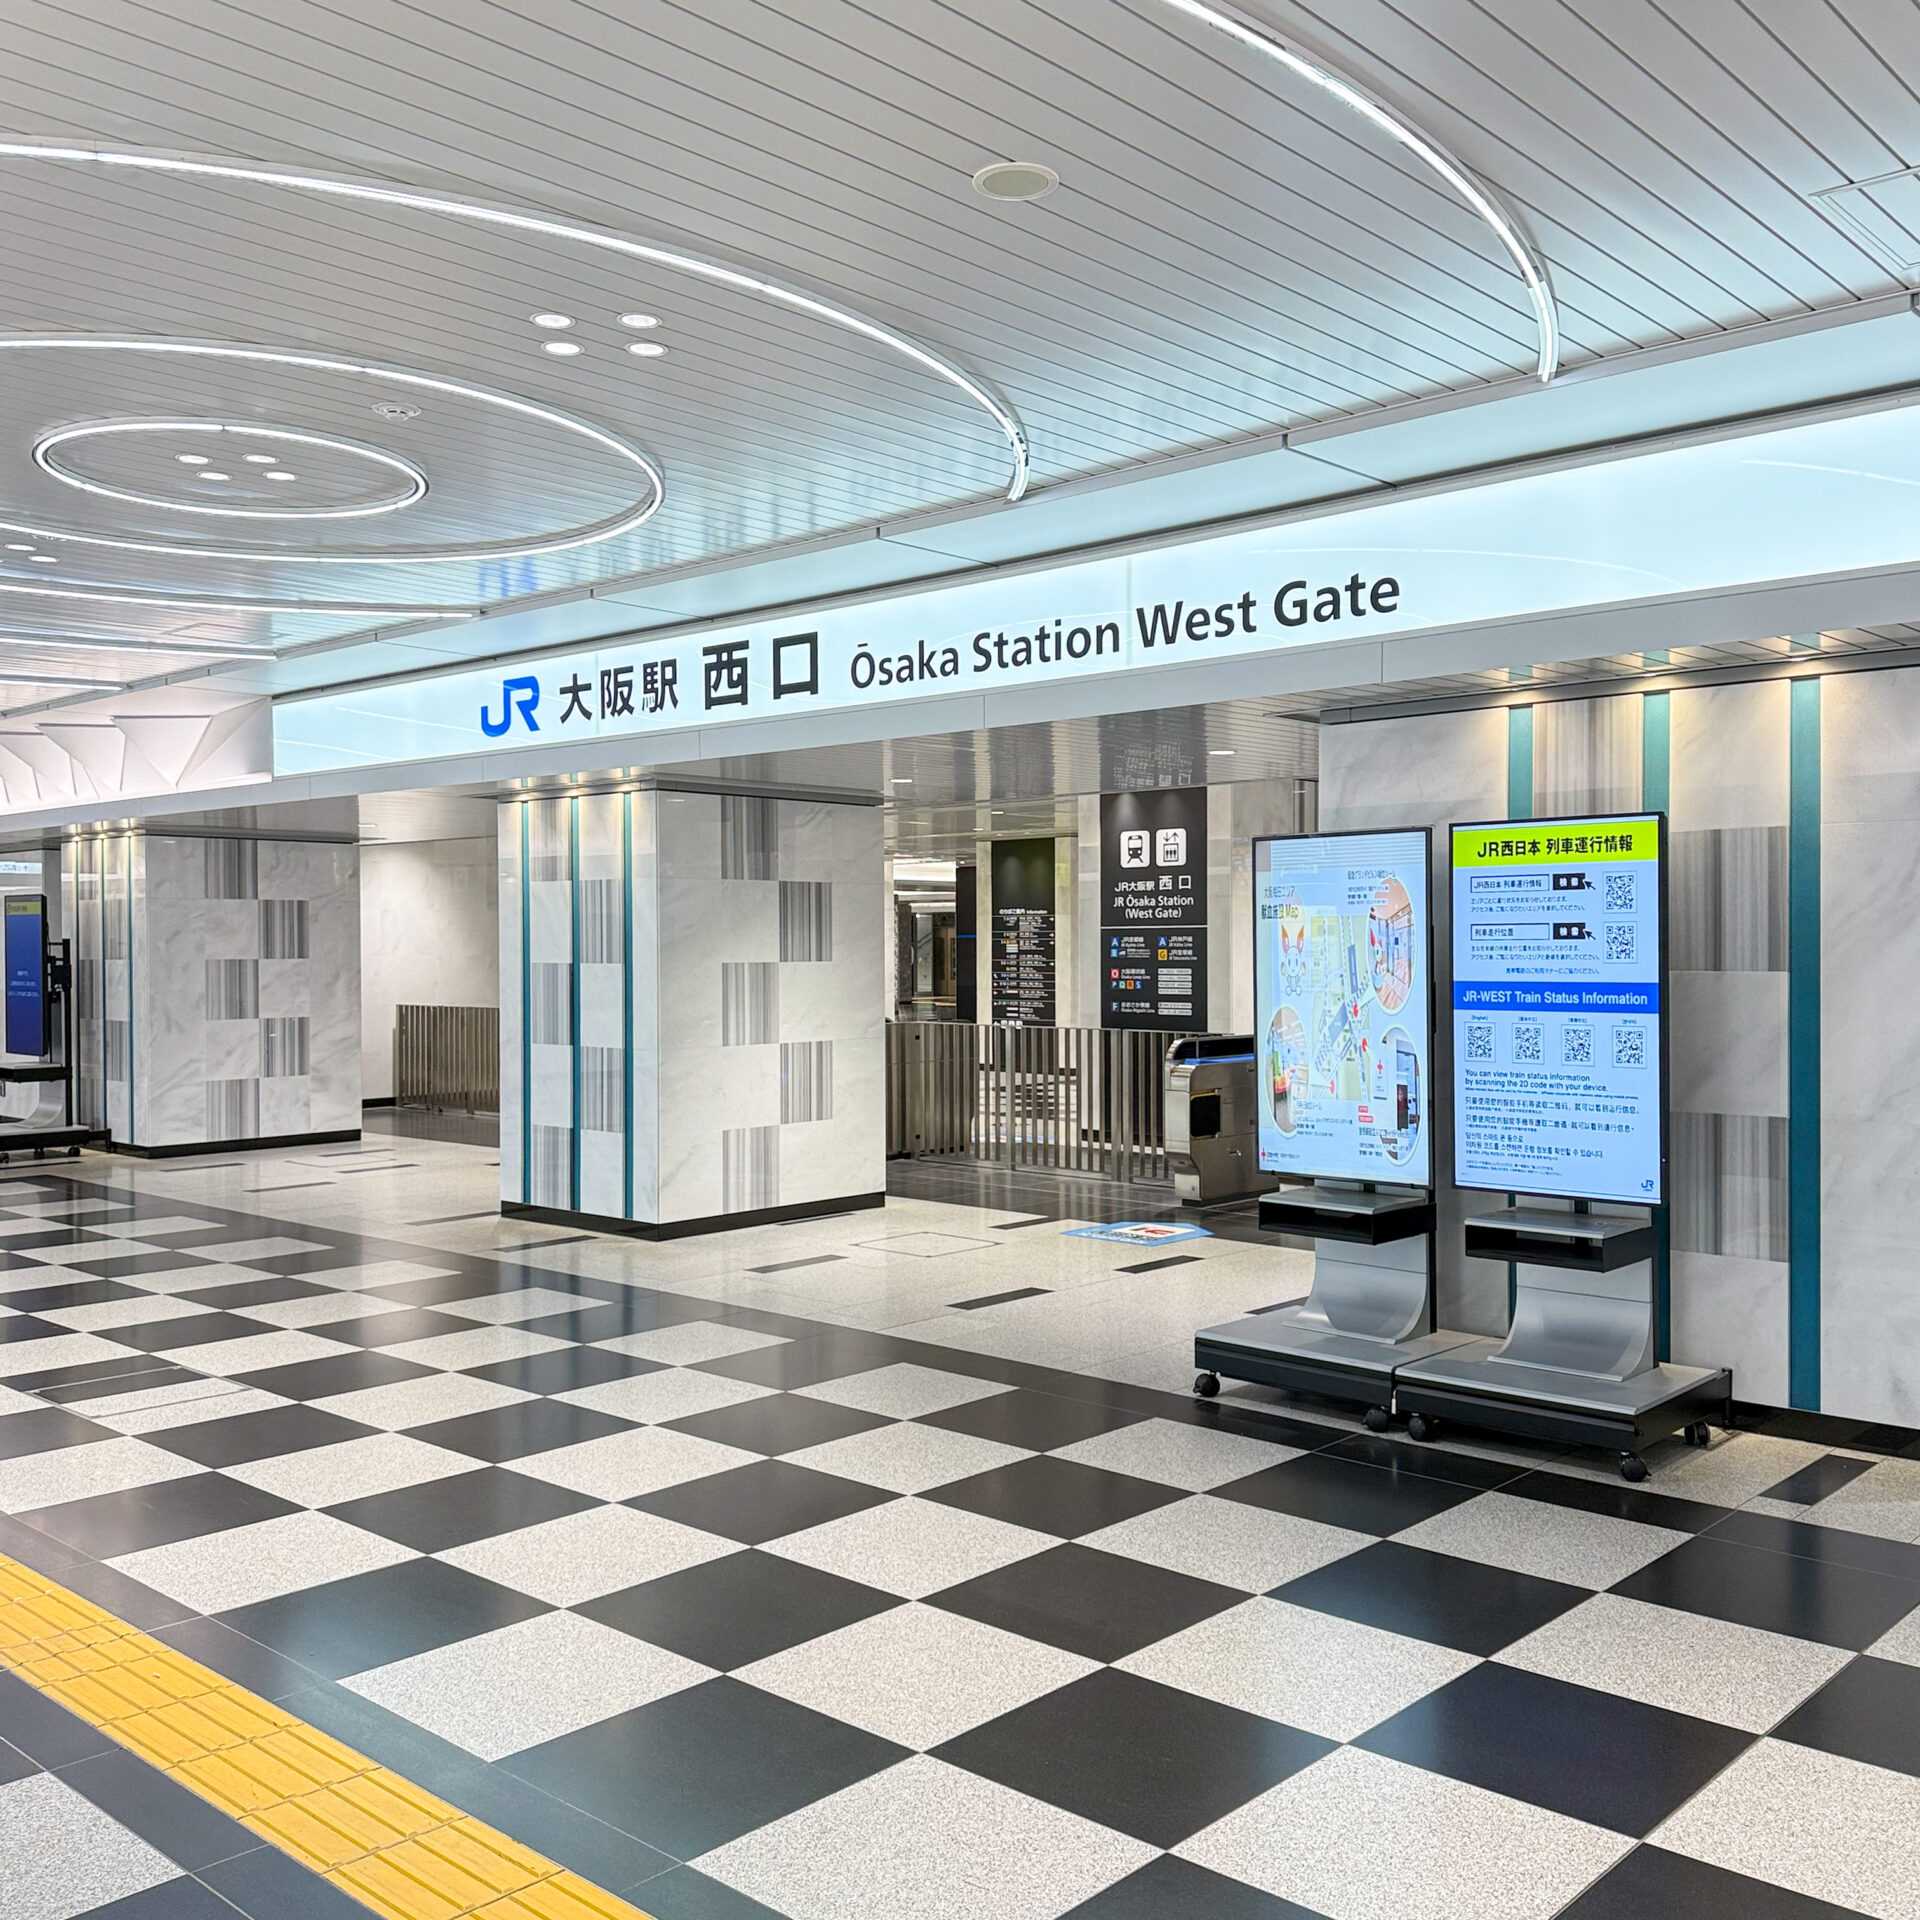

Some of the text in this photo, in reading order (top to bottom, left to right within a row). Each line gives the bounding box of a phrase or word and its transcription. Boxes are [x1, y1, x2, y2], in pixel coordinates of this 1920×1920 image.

[481, 676, 540, 737] JR
[560, 659, 678, 723] 大阪駅
[851, 639, 959, 688] Ōsaka
[972, 619, 1120, 673] Station
[1136, 591, 1257, 648] West
[1274, 572, 1400, 628] Gate
[1477, 834, 1633, 858] JR西日本 列車運行情報
[1113, 897, 1124, 907] JR
[1158, 895, 1194, 906] Station
[1125, 907, 1182, 919] (West Gate)
[1463, 990, 1648, 1005] JR-WEST Train Status Information
[1465, 1069, 1477, 1077] You
[1550, 1072, 1590, 1081] information
[1465, 1078, 1473, 1086] by
[1475, 1080, 1505, 1088] scanning
[1641, 1179, 1654, 1189] JR
